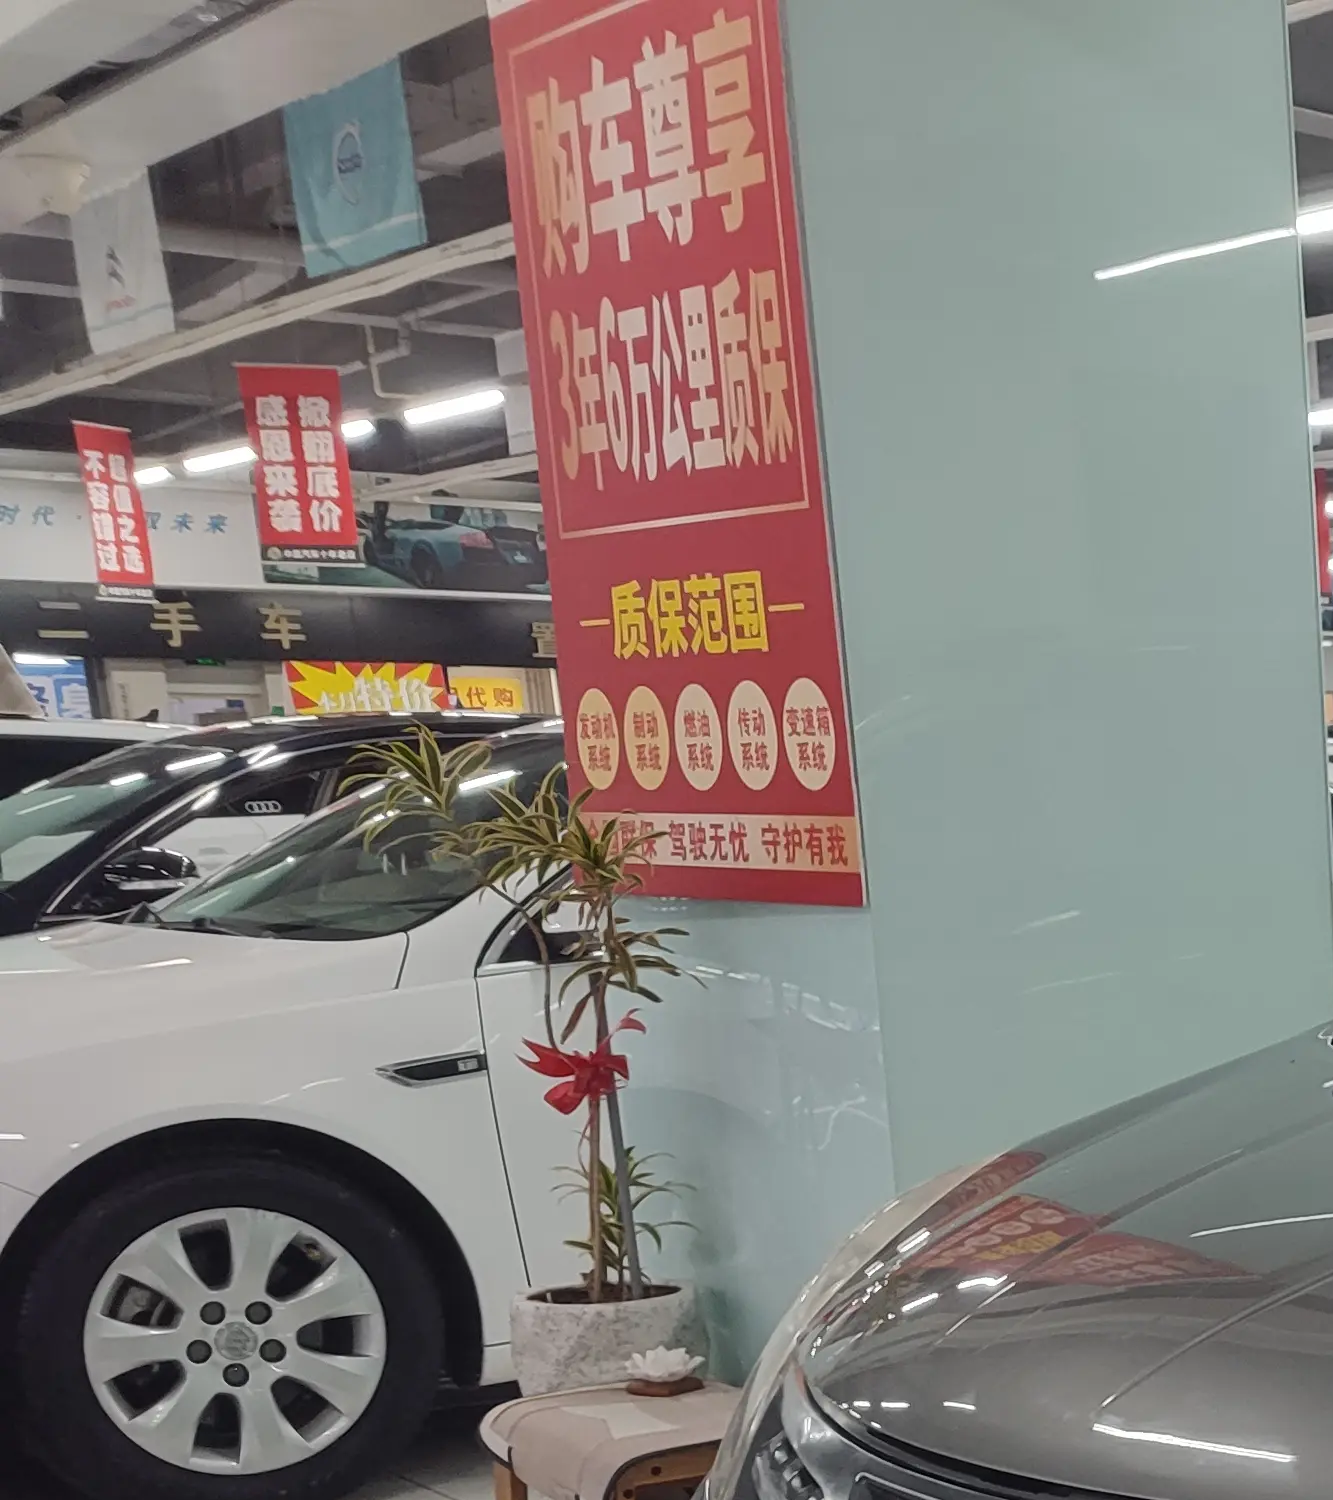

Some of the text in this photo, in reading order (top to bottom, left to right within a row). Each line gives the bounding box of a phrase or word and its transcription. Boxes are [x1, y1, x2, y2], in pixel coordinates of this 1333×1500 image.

[526, 8, 766, 279] 购车尊享
[549, 268, 795, 491] 3年6万公里质保
[610, 570, 769, 661] 质保范围
[579, 712, 616, 740] 发动机
[632, 709, 659, 738] 制动
[683, 708, 711, 738] 燃油
[737, 707, 766, 737] 传动
[785, 706, 831, 737] 变速箱
[587, 744, 613, 771] 系统
[634, 743, 662, 771] 系统
[686, 742, 714, 771] 系统
[740, 742, 770, 770] 系统
[796, 741, 828, 771] 系统
[668, 820, 750, 863] 驾驶无忧
[761, 821, 849, 867] 守护有我
